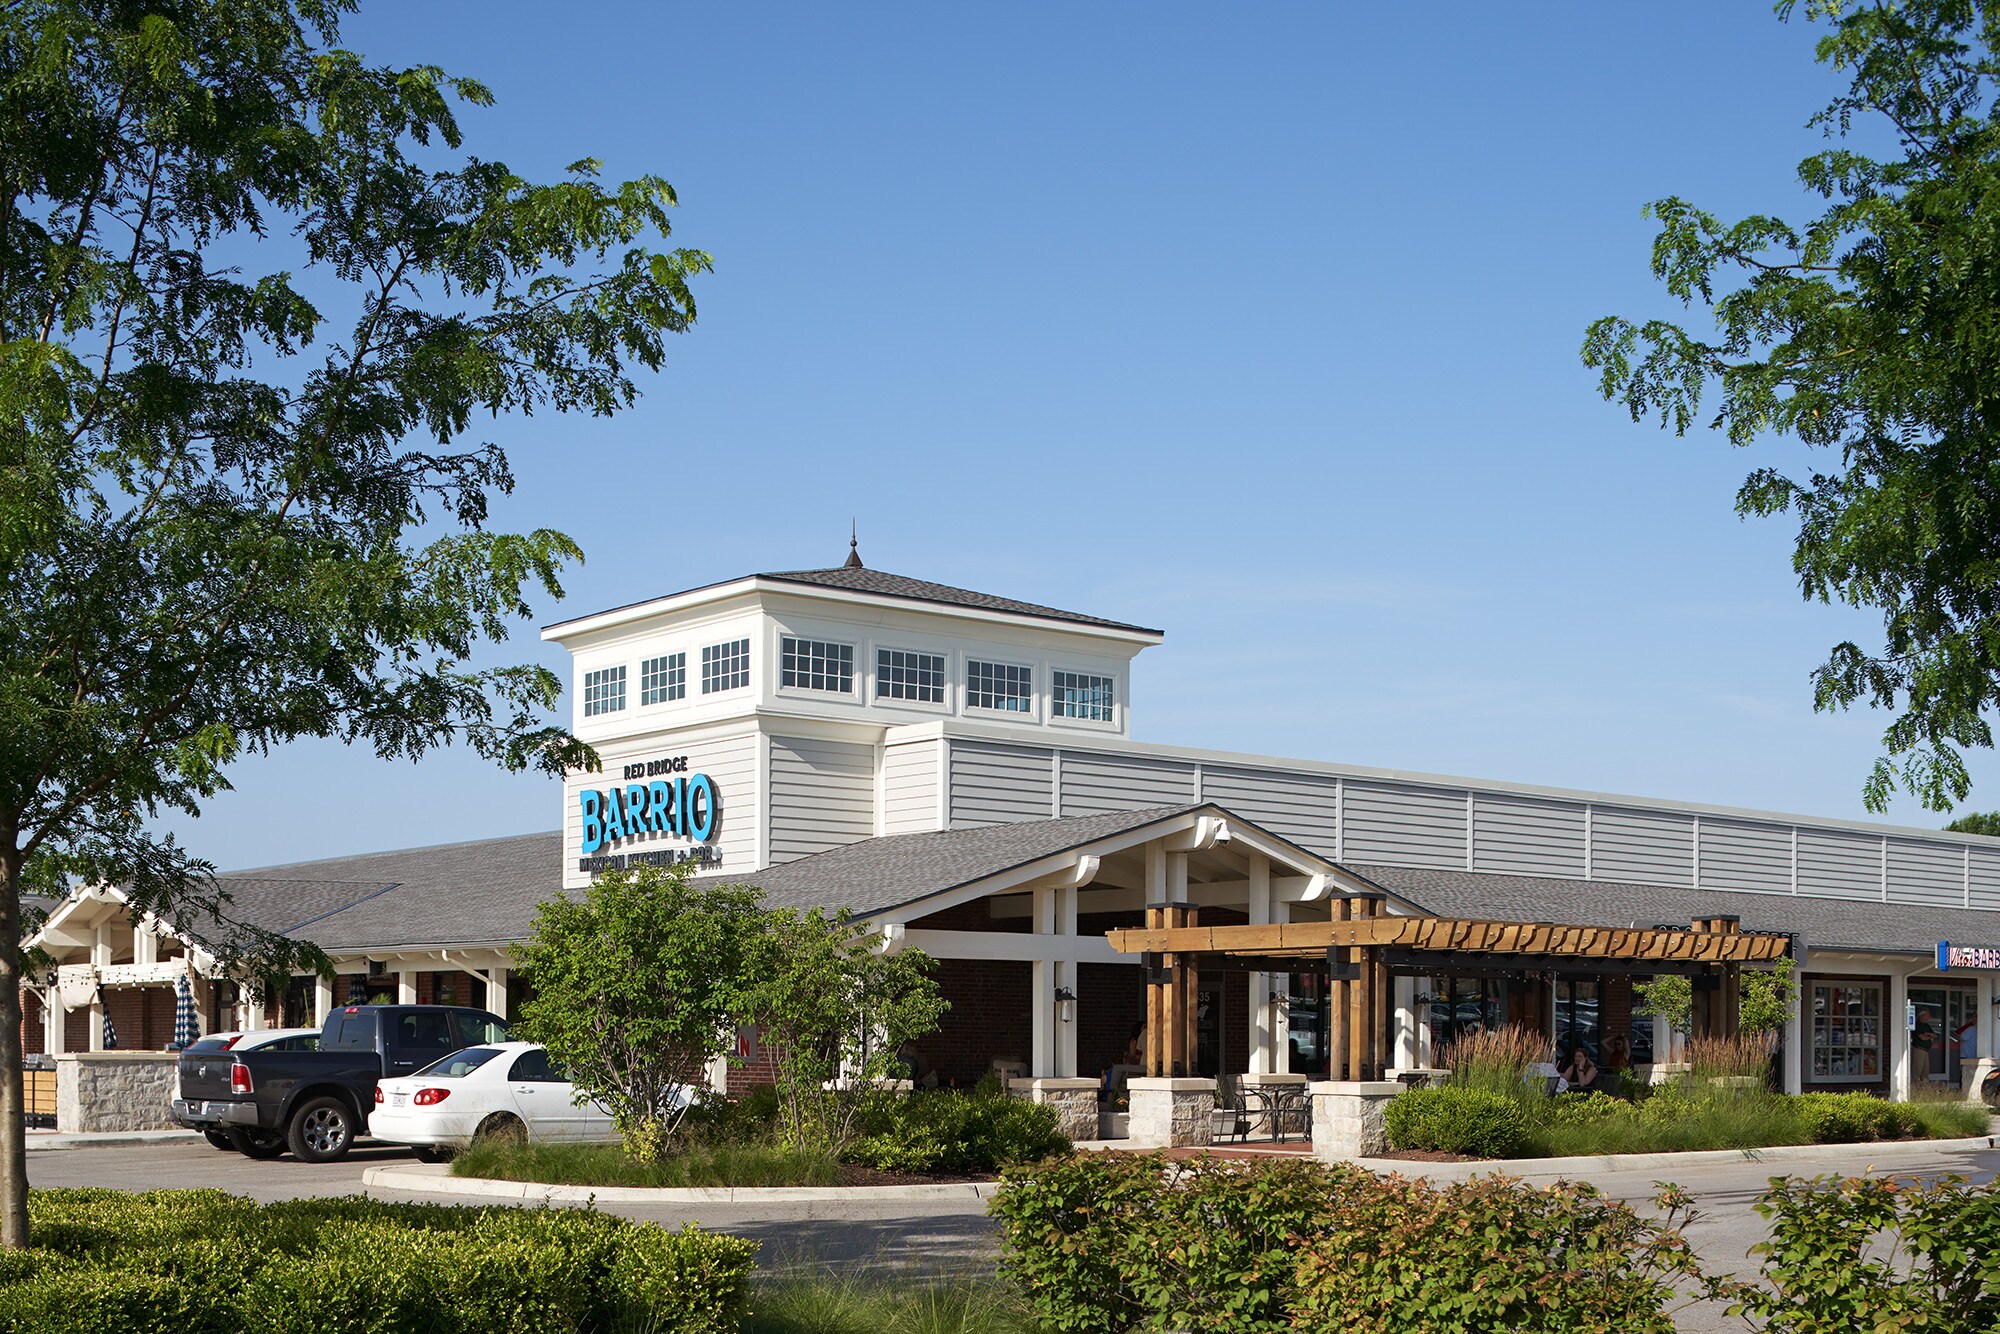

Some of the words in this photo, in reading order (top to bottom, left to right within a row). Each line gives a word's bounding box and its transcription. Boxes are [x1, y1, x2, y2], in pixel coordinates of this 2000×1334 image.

[624, 765, 645, 780] RED
[647, 756, 688, 777] BRIDGE
[580, 773, 717, 854] BARRIO
[579, 854, 625, 872] MEXICAN
[628, 850, 674, 868] KITCHEN
[690, 846, 712, 863] BAR
[1974, 948, 2000, 968] BARB
